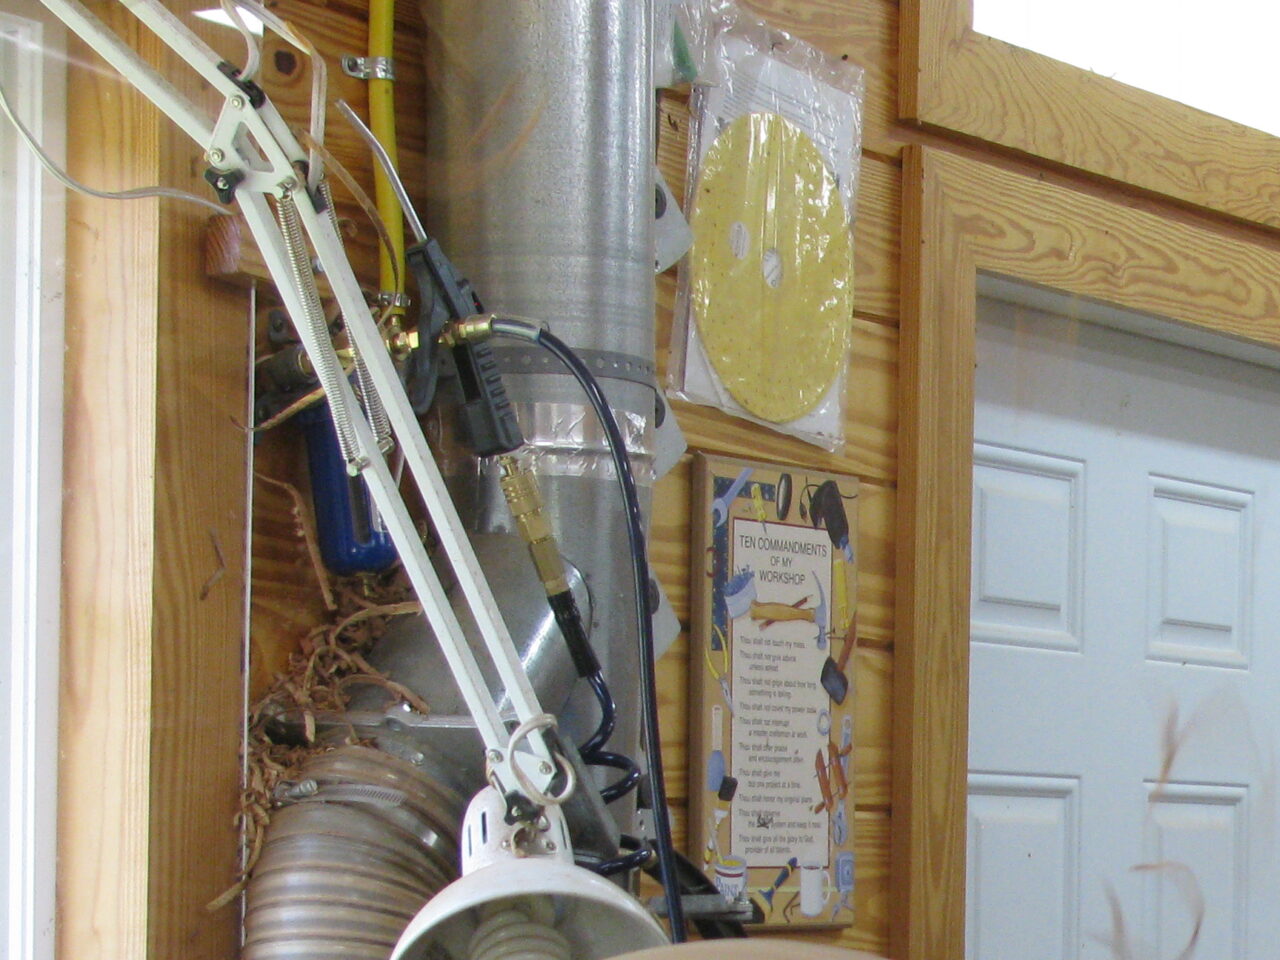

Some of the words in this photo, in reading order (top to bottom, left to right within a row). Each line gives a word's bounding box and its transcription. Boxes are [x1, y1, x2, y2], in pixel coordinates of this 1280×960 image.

[740, 534, 756, 549] TEN
[758, 537, 827, 557] COMMANDMENTS
[770, 556, 780, 566] OF
[782, 556, 792, 568] MY
[760, 570, 806, 586] WORKSHOP
